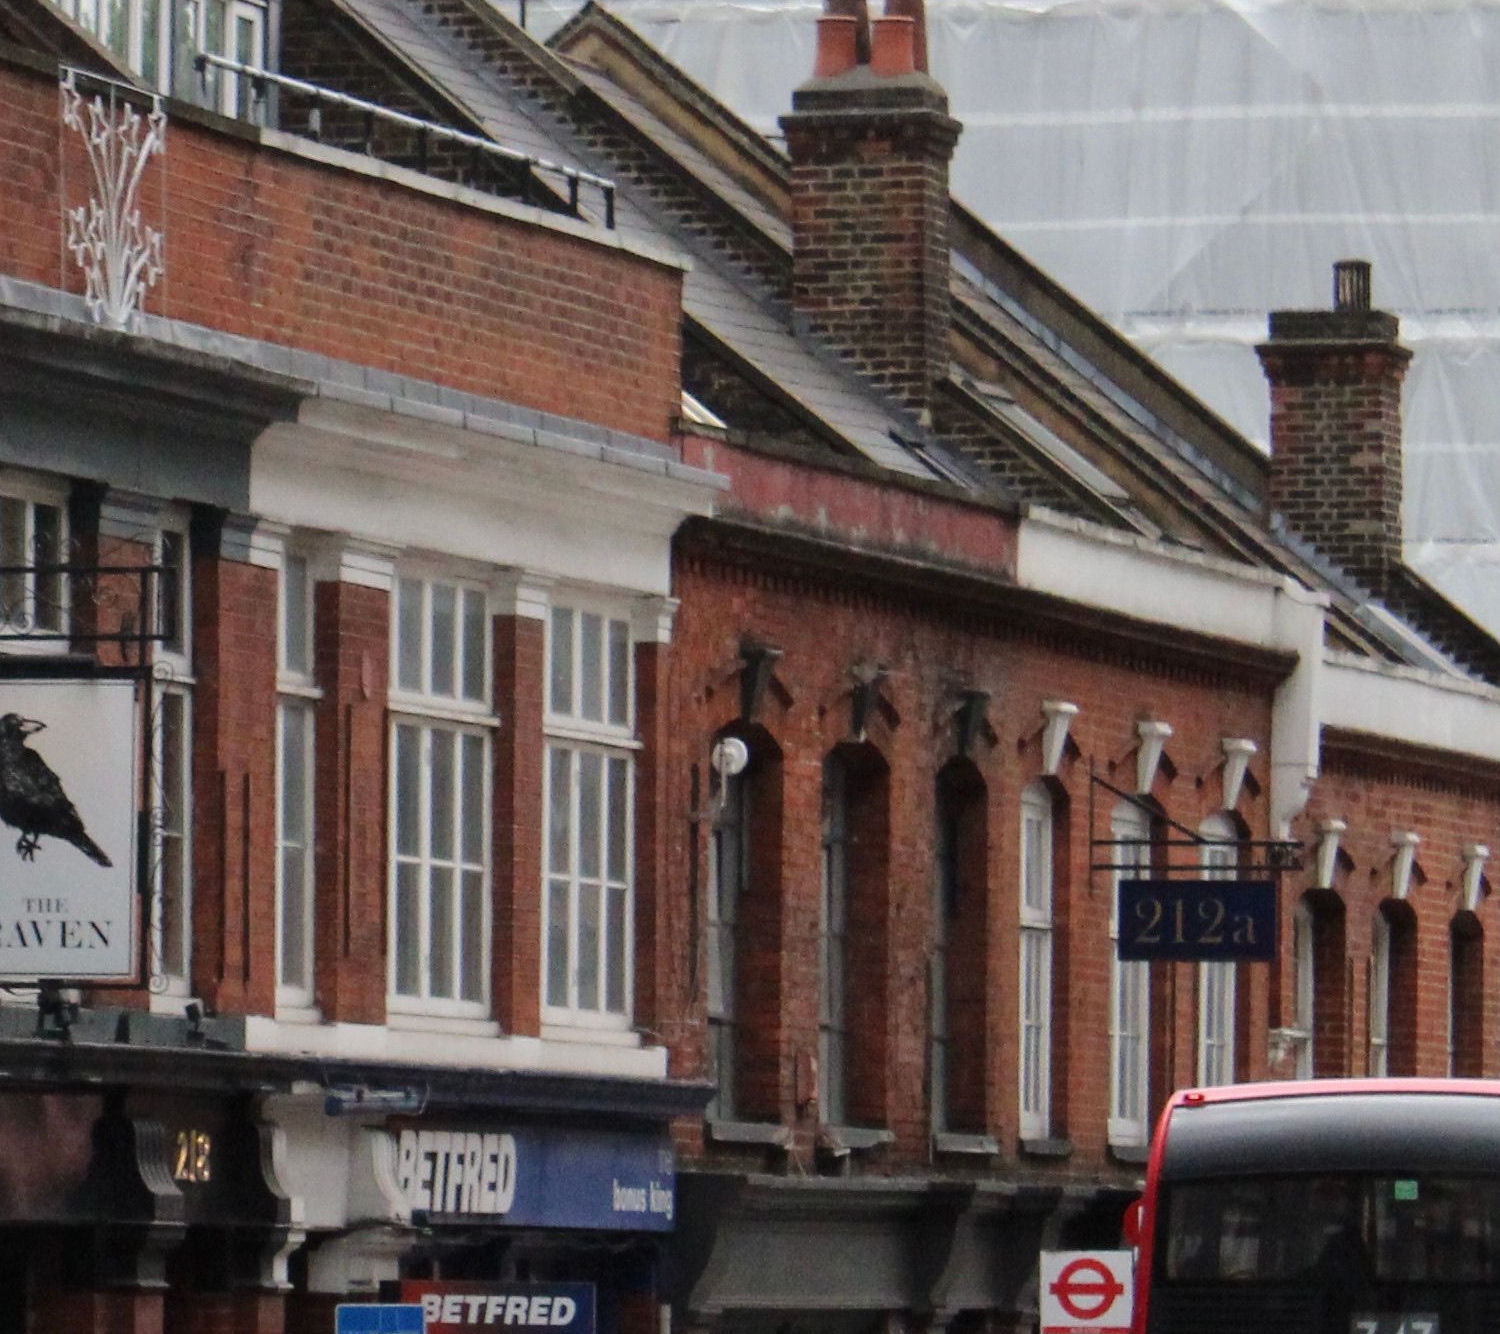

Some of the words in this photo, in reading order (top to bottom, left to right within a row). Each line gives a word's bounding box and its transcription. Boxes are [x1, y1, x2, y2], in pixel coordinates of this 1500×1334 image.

[22, 898, 69, 913] THE
[1135, 898, 1256, 944] 212a
[398, 1129, 516, 1214] BETFRED
[613, 1178, 647, 1213] bonus
[649, 1180, 674, 1221] king
[420, 1294, 577, 1326] BETFRED
